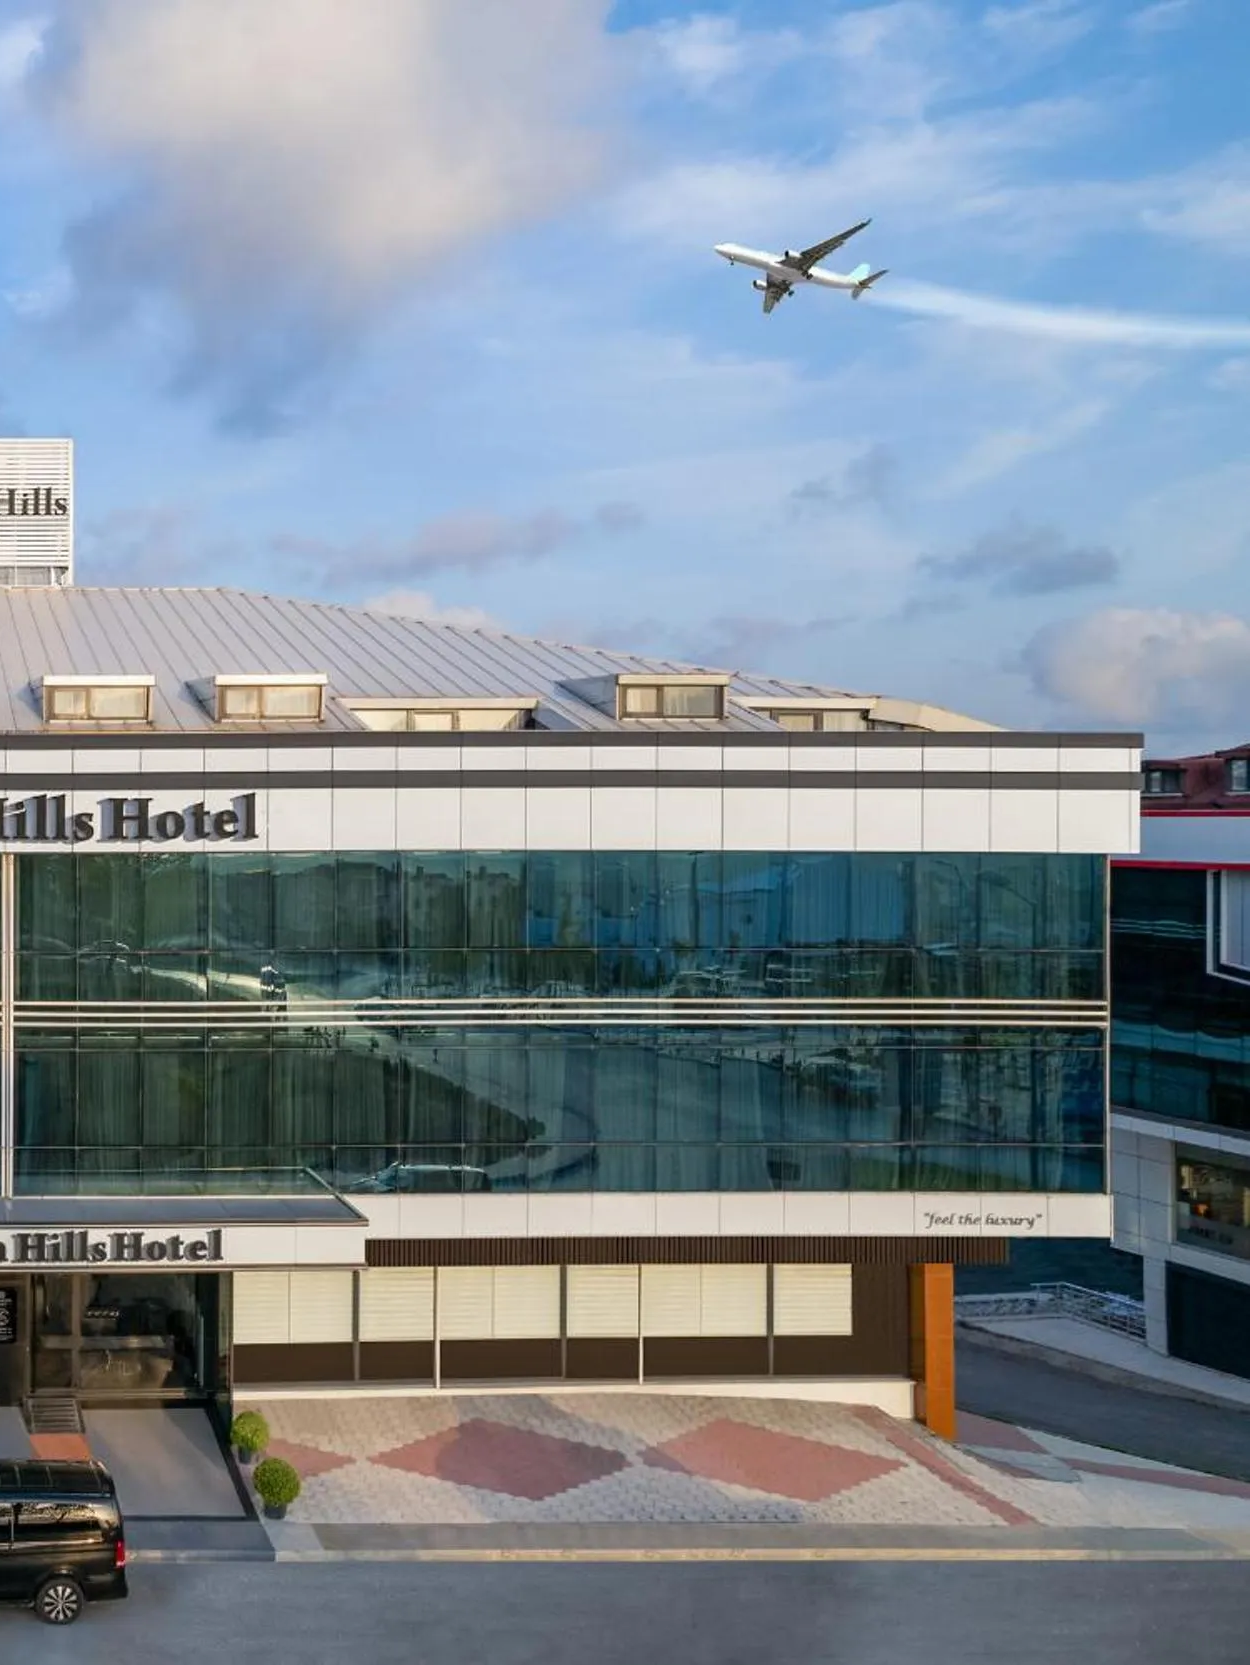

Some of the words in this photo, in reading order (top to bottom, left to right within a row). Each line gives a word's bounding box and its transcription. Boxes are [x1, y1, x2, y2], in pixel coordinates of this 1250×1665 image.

[97, 793, 259, 842] Hotel
[958, 1212, 982, 1226] the
[11, 1230, 107, 1263] Hills
[108, 1228, 224, 1262] Hotel
